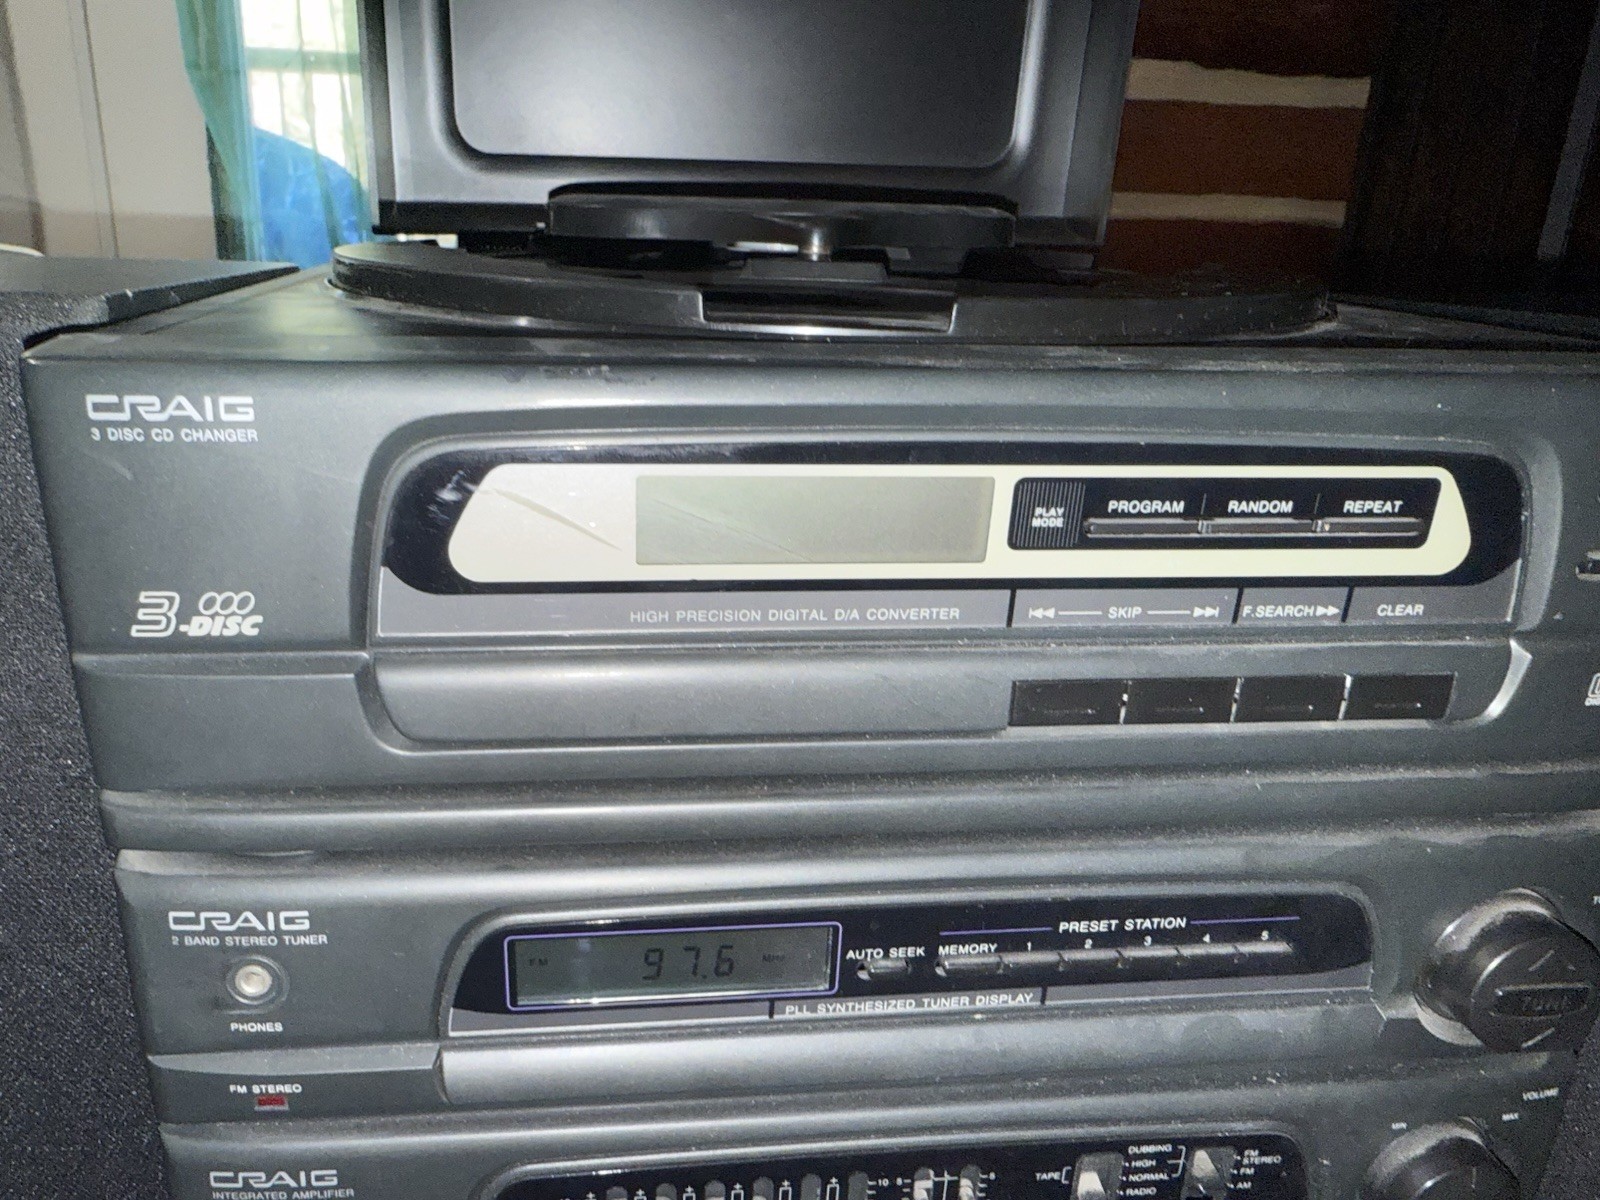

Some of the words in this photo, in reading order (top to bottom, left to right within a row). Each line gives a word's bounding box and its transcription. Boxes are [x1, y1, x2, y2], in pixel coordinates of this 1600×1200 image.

[85, 394, 255, 422] CRAIG
[91, 428, 101, 442] 3
[107, 428, 145, 443] DISC
[151, 428, 174, 443] CD
[180, 428, 259, 443] CHANGER
[1034, 506, 1066, 518] PLAY
[1107, 500, 1185, 514] PROGRAM
[1227, 500, 1294, 514] RANDOM
[1343, 499, 1404, 514] REPEAT
[1032, 517, 1065, 529] MODE
[629, 610, 669, 624] HIGH
[675, 609, 762, 623] PRECISION
[768, 608, 828, 622] DIGITAL
[834, 608, 860, 622] D/A
[866, 607, 960, 621] CONVERTER
[1107, 605, 1142, 619] SKIP
[1242, 604, 1315, 619] F.SEARCH
[1376, 603, 1425, 617] CLEAR
[168, 910, 310, 931] CRAIG
[1058, 919, 1117, 934] PRESET
[1124, 916, 1187, 931] STATION
[171, 936, 179, 946] 2
[184, 935, 220, 947] BAND
[224, 934, 278, 947] STEREO
[282, 933, 328, 946] TUNER
[1084, 938, 1093, 949] 2
[1202, 933, 1211, 943] 4
[846, 948, 884, 960] AUTO
[889, 946, 925, 958] SEEK
[938, 943, 998, 956] MEMORY
[642, 945, 735, 981] 97.6
[785, 1004, 811, 1016] PLL
[817, 999, 916, 1014] SYNTHESIZED
[921, 996, 970, 1009] TUNER
[975, 993, 1034, 1006] DISPLAY
[230, 1022, 283, 1032] PHONES
[229, 1084, 248, 1094] FM
[252, 1083, 303, 1094] STEREO
[1128, 1143, 1173, 1155] DUBBING
[1131, 1158, 1156, 1168] HIGH
[1242, 1155, 1282, 1165] STEREO
[209, 1169, 338, 1189] CRAIG
[1035, 1170, 1061, 1181] TAPE
[1128, 1172, 1170, 1182] NORMAL
[1126, 1186, 1157, 1196] RADIO
[1236, 1181, 1251, 1190] AM
[212, 1190, 288, 1200] INTEGRATED
[291, 1188, 355, 1200] AMPLIFIER
